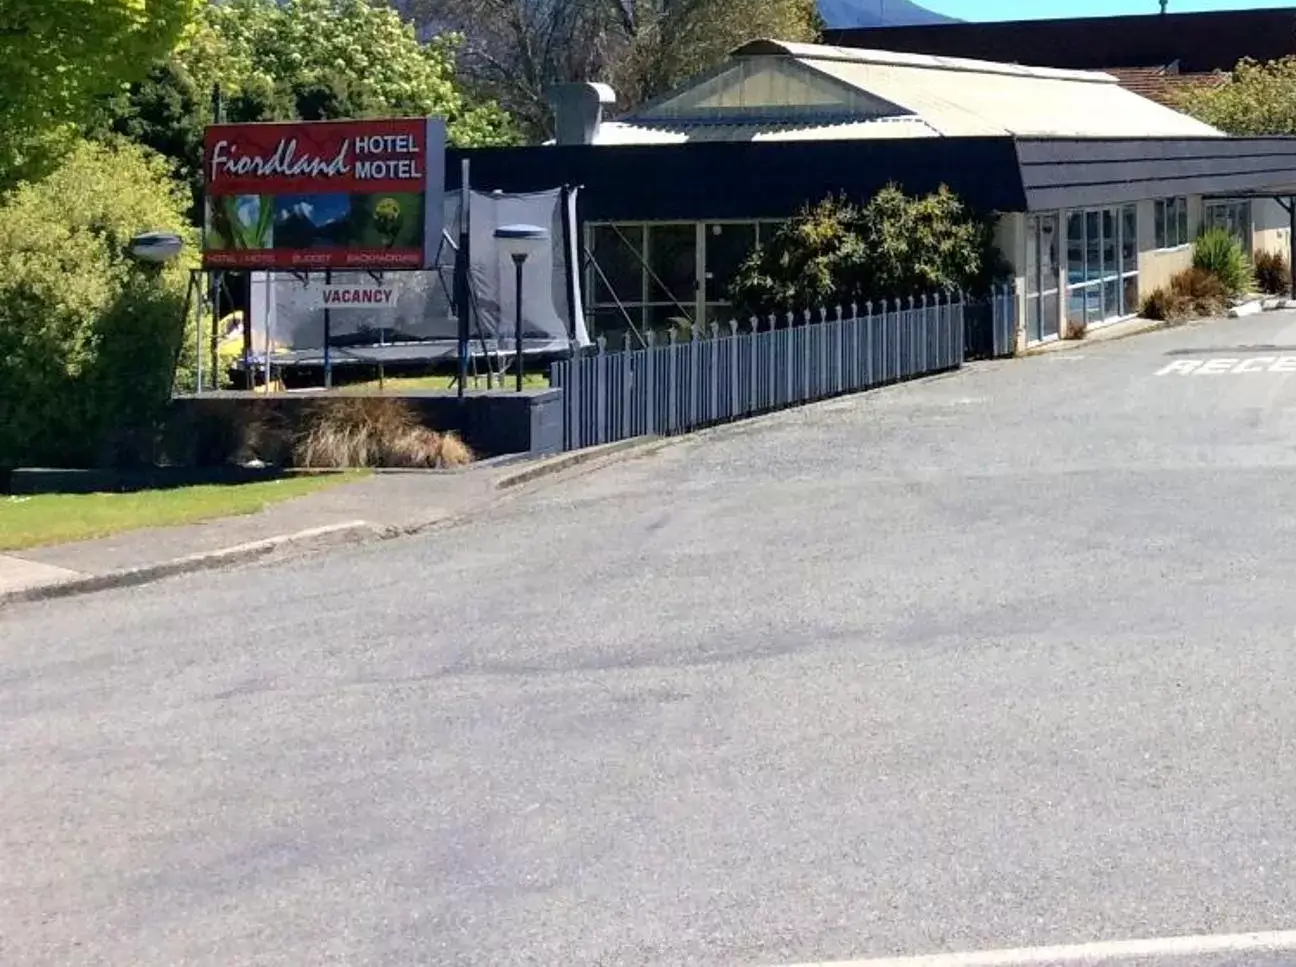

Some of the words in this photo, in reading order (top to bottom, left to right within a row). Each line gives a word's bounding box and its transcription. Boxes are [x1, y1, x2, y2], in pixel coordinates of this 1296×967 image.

[355, 135, 420, 154] HOTEL
[212, 136, 350, 182] Fiordland
[355, 160, 422, 180] MOTEL
[322, 289, 393, 304] VACANCY
